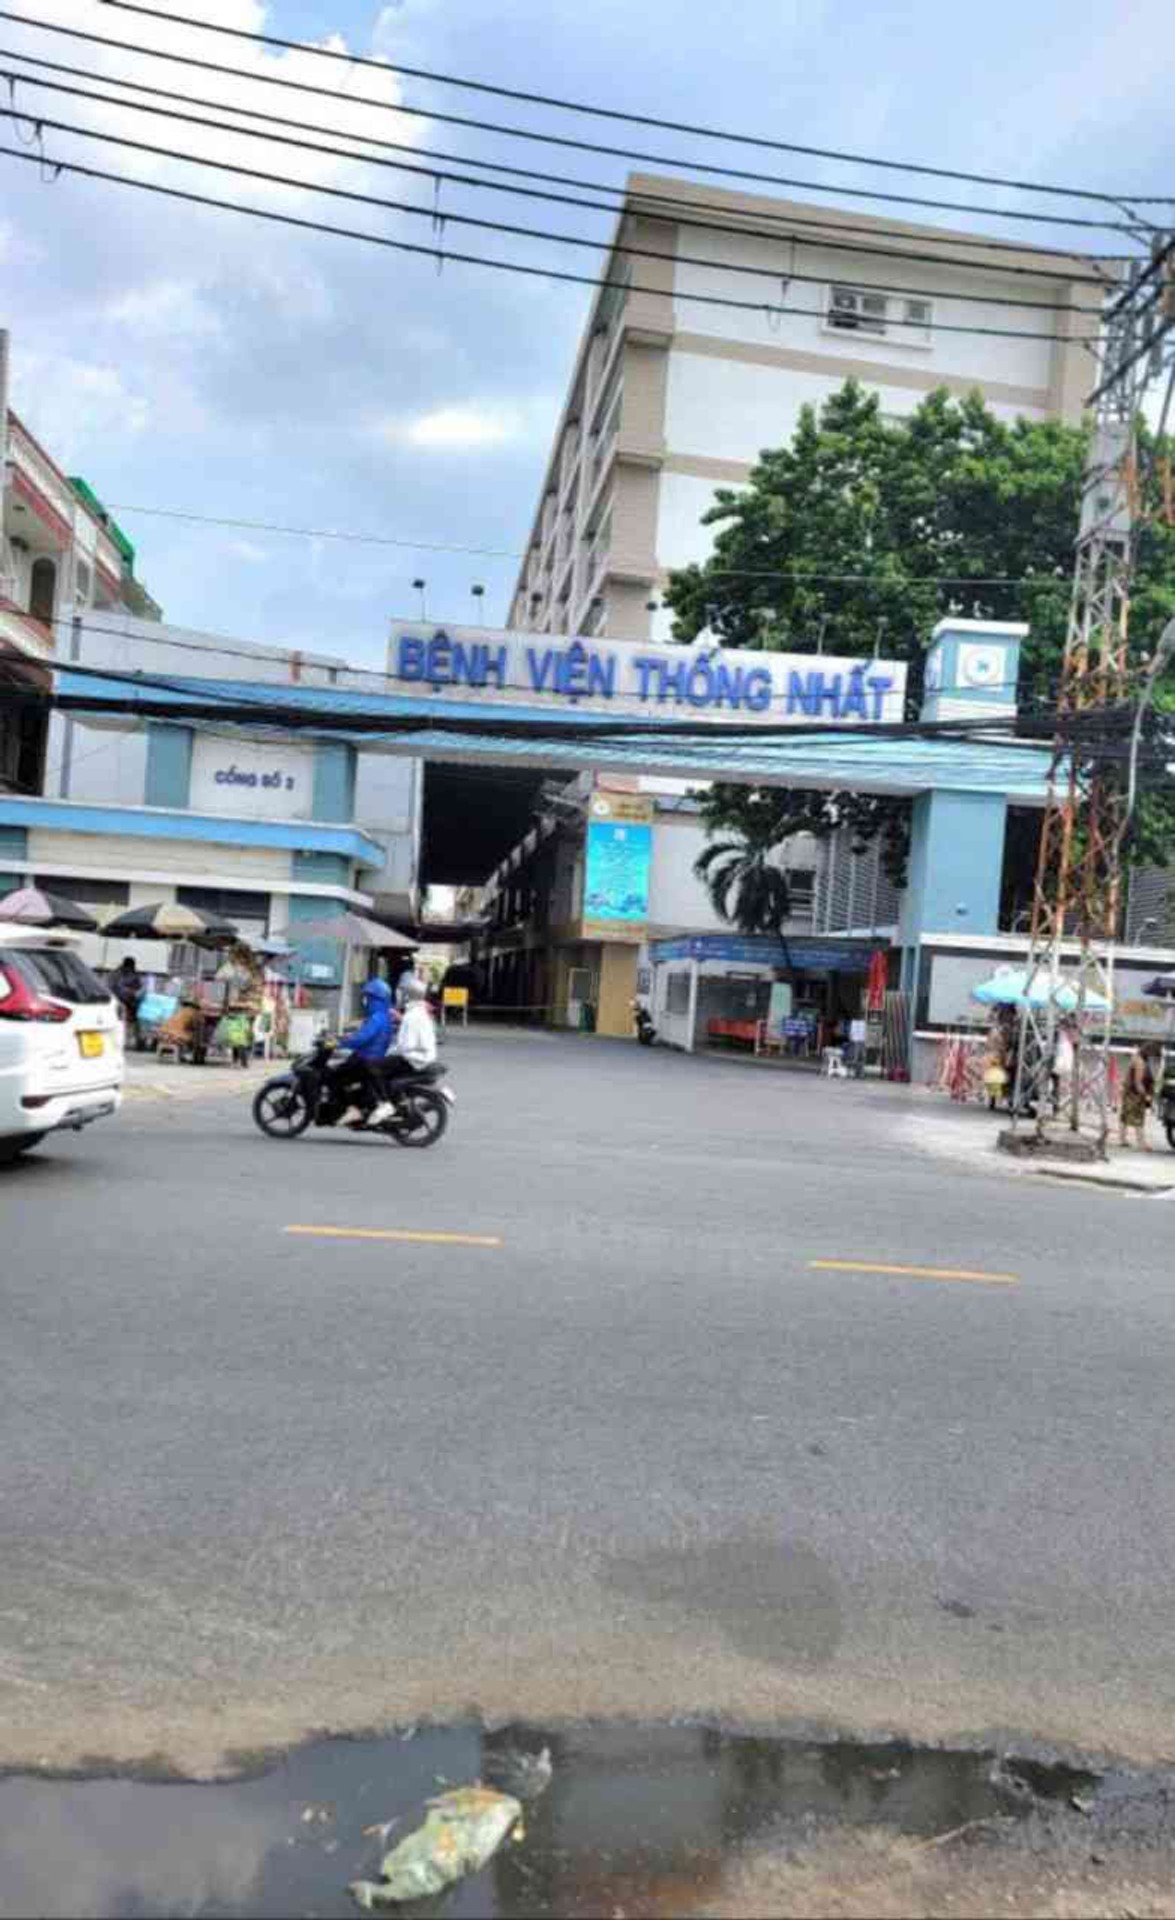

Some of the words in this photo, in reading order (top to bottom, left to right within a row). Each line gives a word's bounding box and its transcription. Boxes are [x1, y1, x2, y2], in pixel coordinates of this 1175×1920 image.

[398, 629, 506, 692] BỆNH
[527, 640, 615, 703] VIỆN
[632, 647, 772, 712] THỐNG
[787, 658, 894, 721] NHẤT
